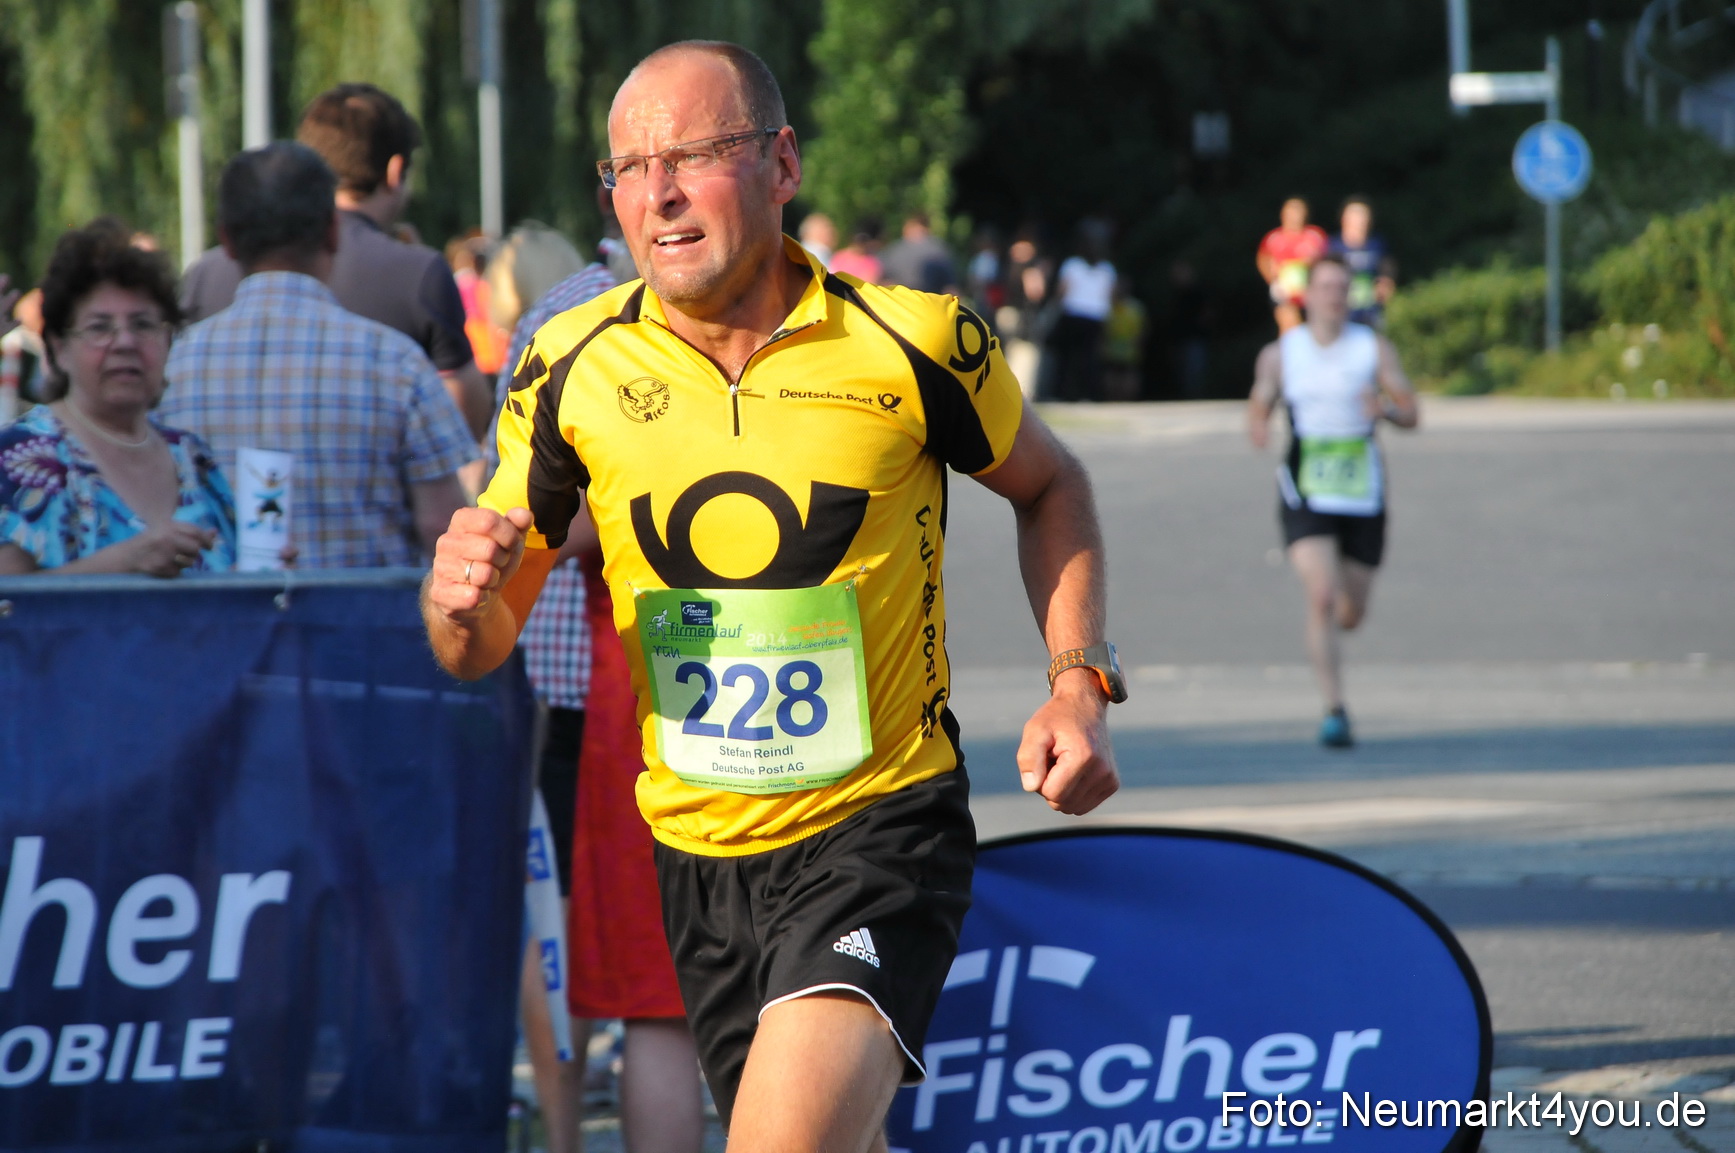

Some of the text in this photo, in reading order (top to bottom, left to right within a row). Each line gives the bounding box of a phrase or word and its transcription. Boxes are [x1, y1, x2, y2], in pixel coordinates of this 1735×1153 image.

[779, 388, 874, 406] Deutsche Post
[670, 622, 743, 638] firmenlauf
[745, 633, 788, 647] 2014
[675, 660, 828, 741] 228
[719, 745, 794, 759] Stefan Reindl
[712, 762, 805, 775] Deutsche Post AG
[832, 941, 880, 968] adidas
[911, 1014, 1382, 1131] Fischer
